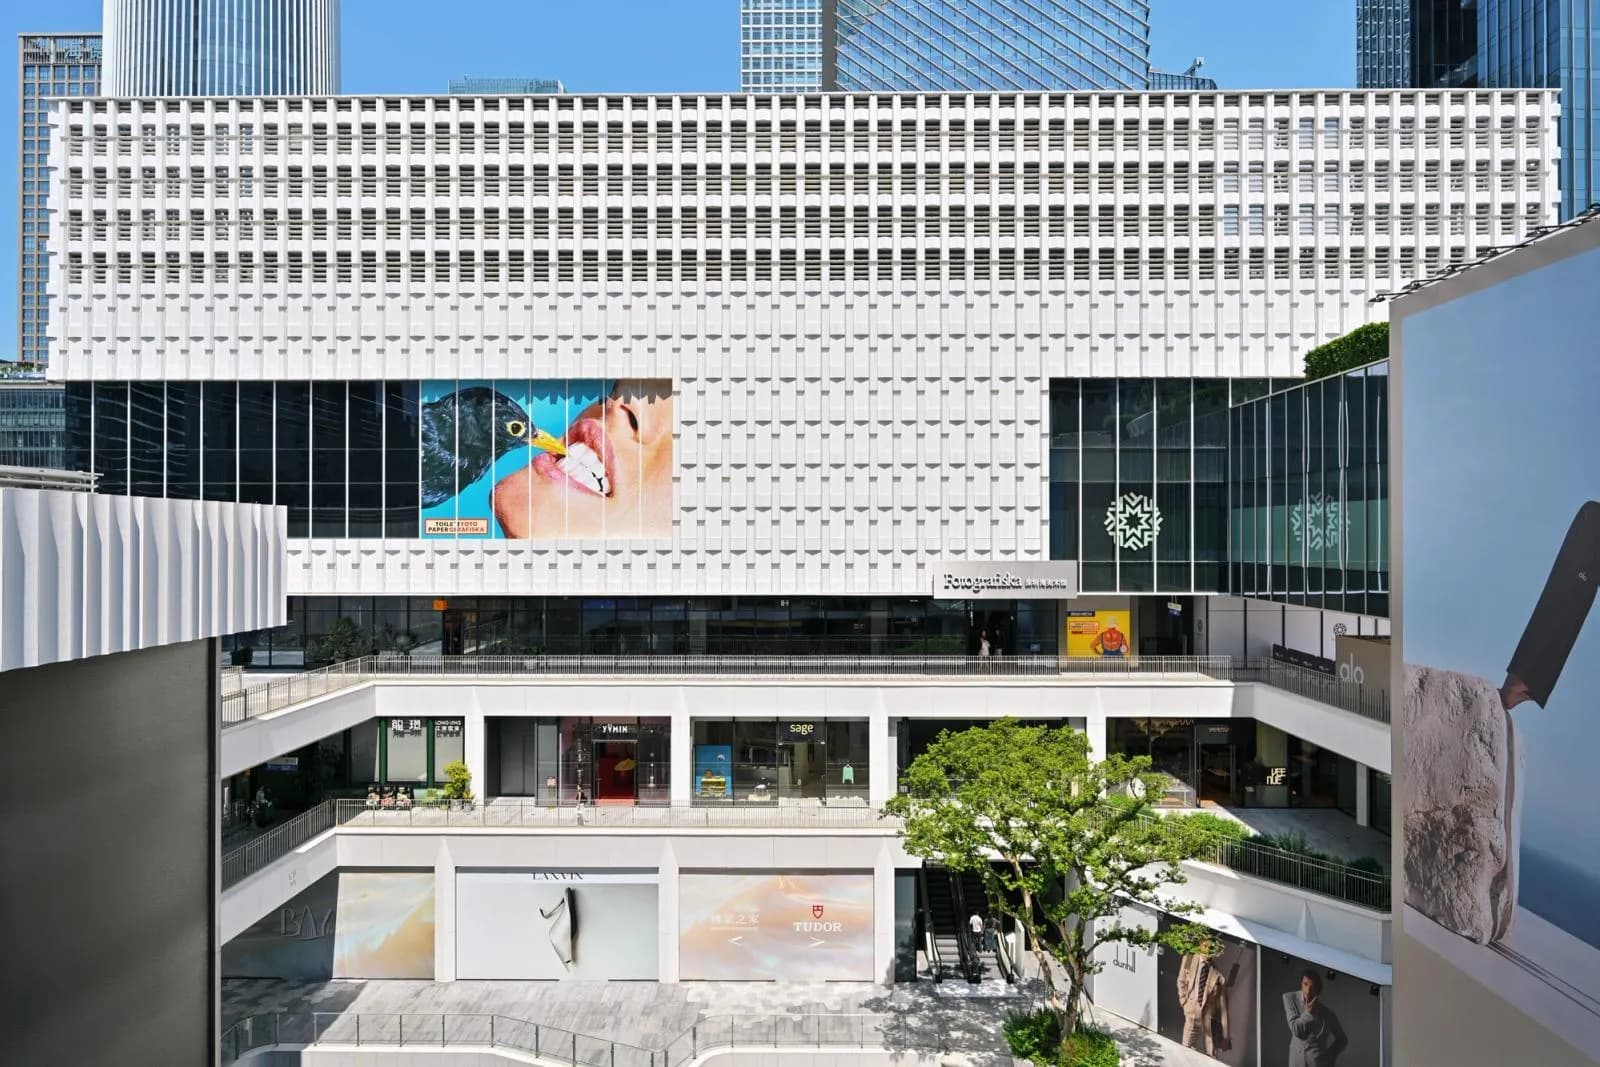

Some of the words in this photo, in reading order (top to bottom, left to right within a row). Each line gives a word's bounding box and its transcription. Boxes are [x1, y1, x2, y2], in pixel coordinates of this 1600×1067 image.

[943, 573, 1022, 594] Fotografiska
[1340, 652, 1364, 684] alo
[790, 724, 814, 736] sage
[530, 871, 584, 880] LANVIN
[793, 921, 842, 932] TUDOR
